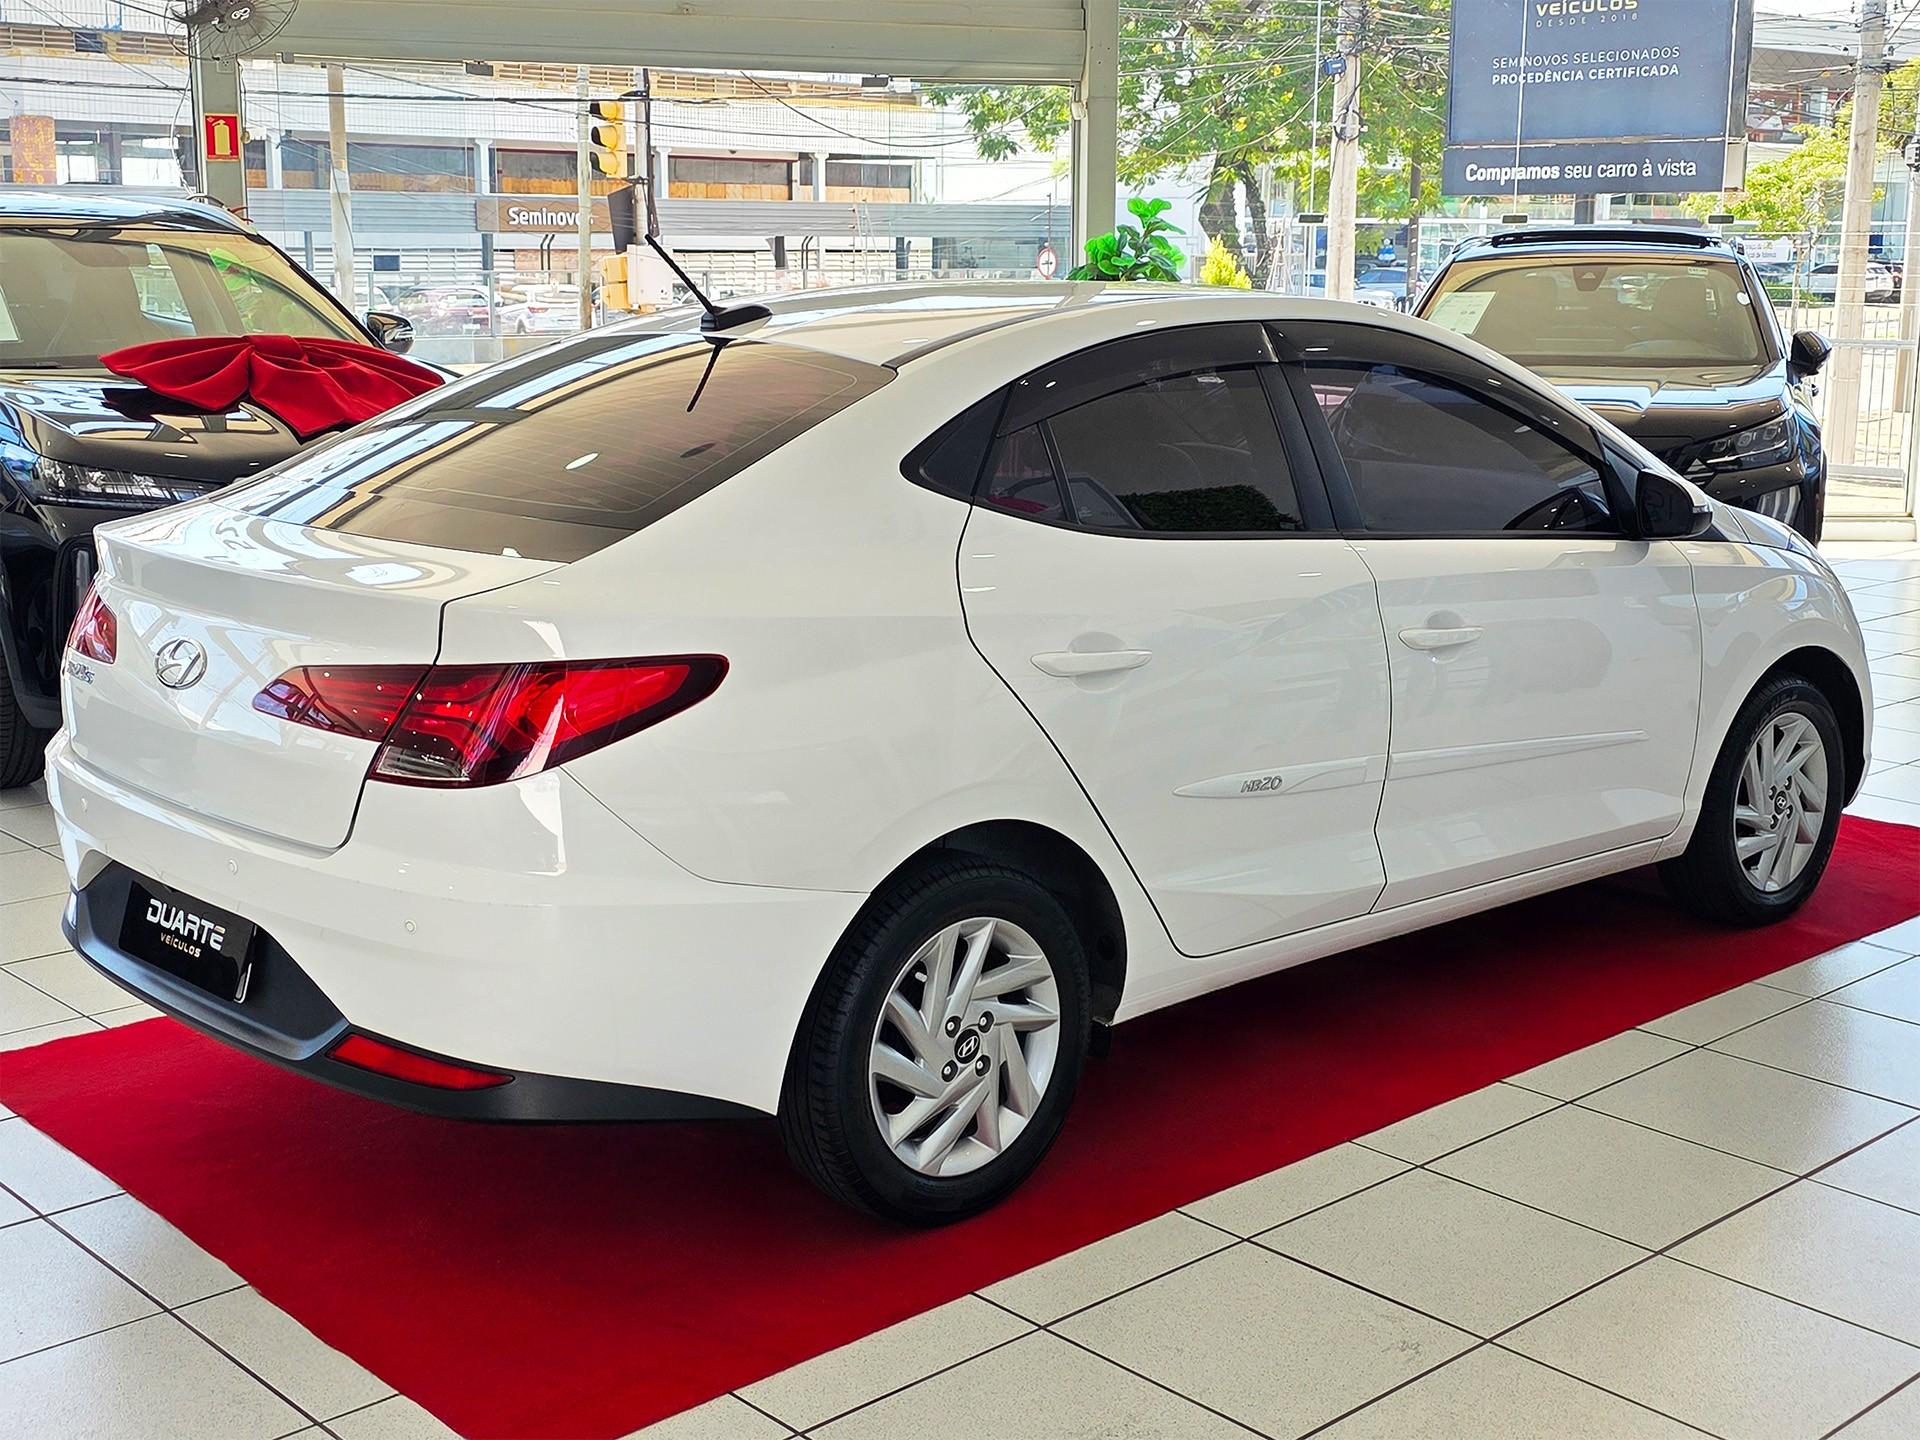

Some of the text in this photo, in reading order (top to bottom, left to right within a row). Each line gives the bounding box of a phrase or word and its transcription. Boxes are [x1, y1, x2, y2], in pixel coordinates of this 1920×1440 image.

[1536, 17, 1587, 28] DESDE
[1493, 46, 1680, 69] SEMINOVOS SELECIONADOS
[1492, 64, 1679, 85] PROCEDÊNCIA CERTIFICADA
[1465, 158, 1697, 185] Compramos seu carro à vista
[508, 206, 594, 225] Seminovo
[1240, 775, 1283, 793] HB20
[146, 898, 226, 951] DUARTE
